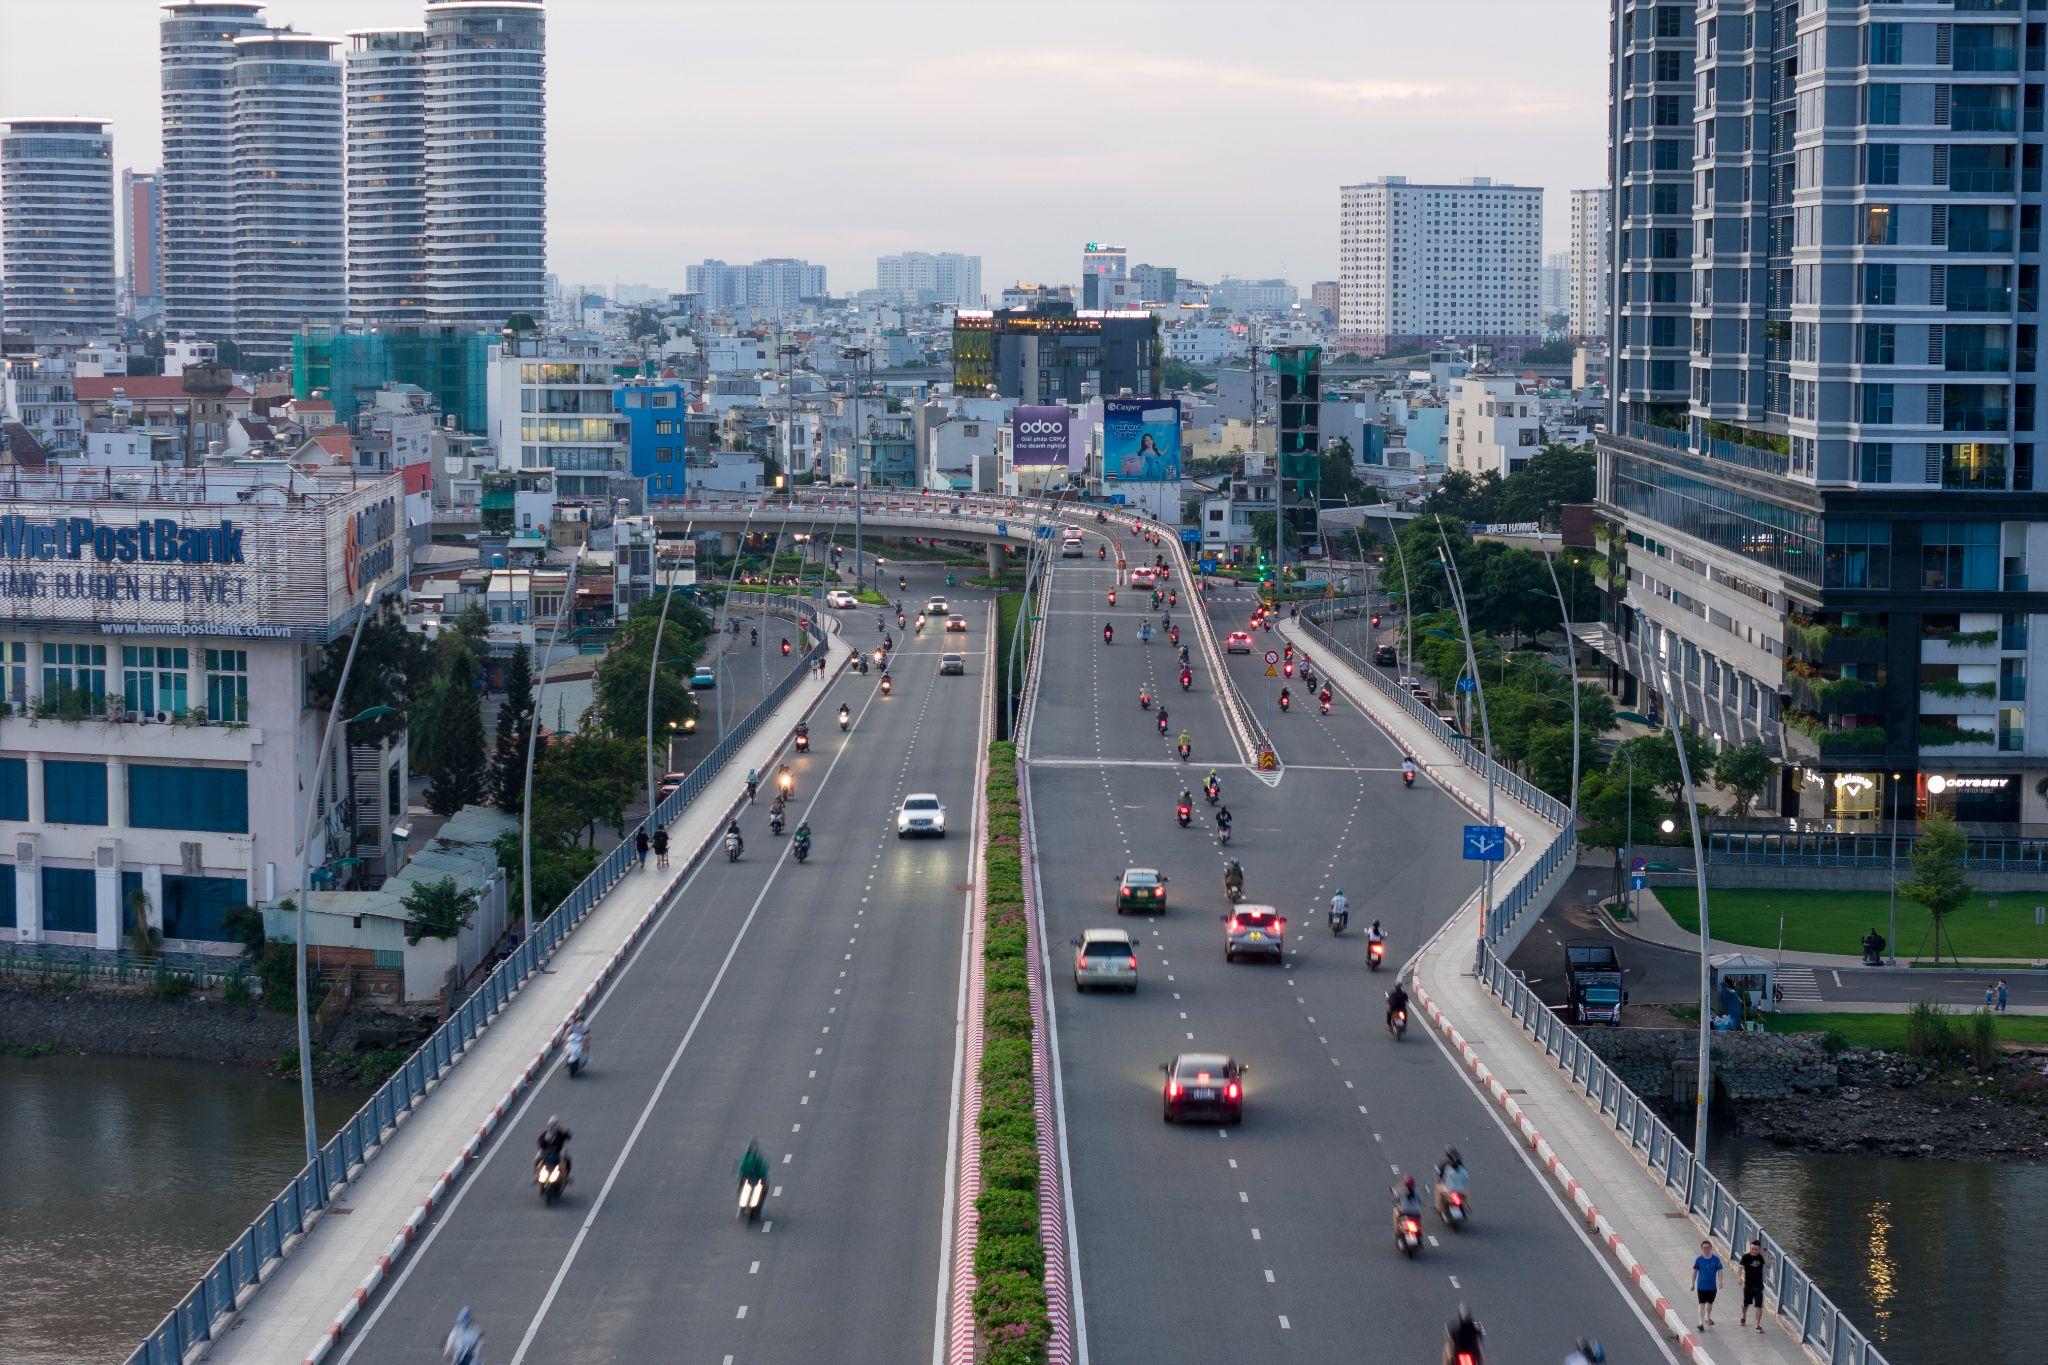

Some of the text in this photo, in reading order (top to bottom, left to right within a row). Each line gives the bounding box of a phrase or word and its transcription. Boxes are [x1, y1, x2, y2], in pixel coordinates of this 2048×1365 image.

[1020, 418, 1063, 434] odoo
[0, 515, 245, 564] VietPostBank
[101, 622, 291, 637] www.lienvietpostbank.com.vn
[1945, 779, 2009, 787] ODYSSEY
